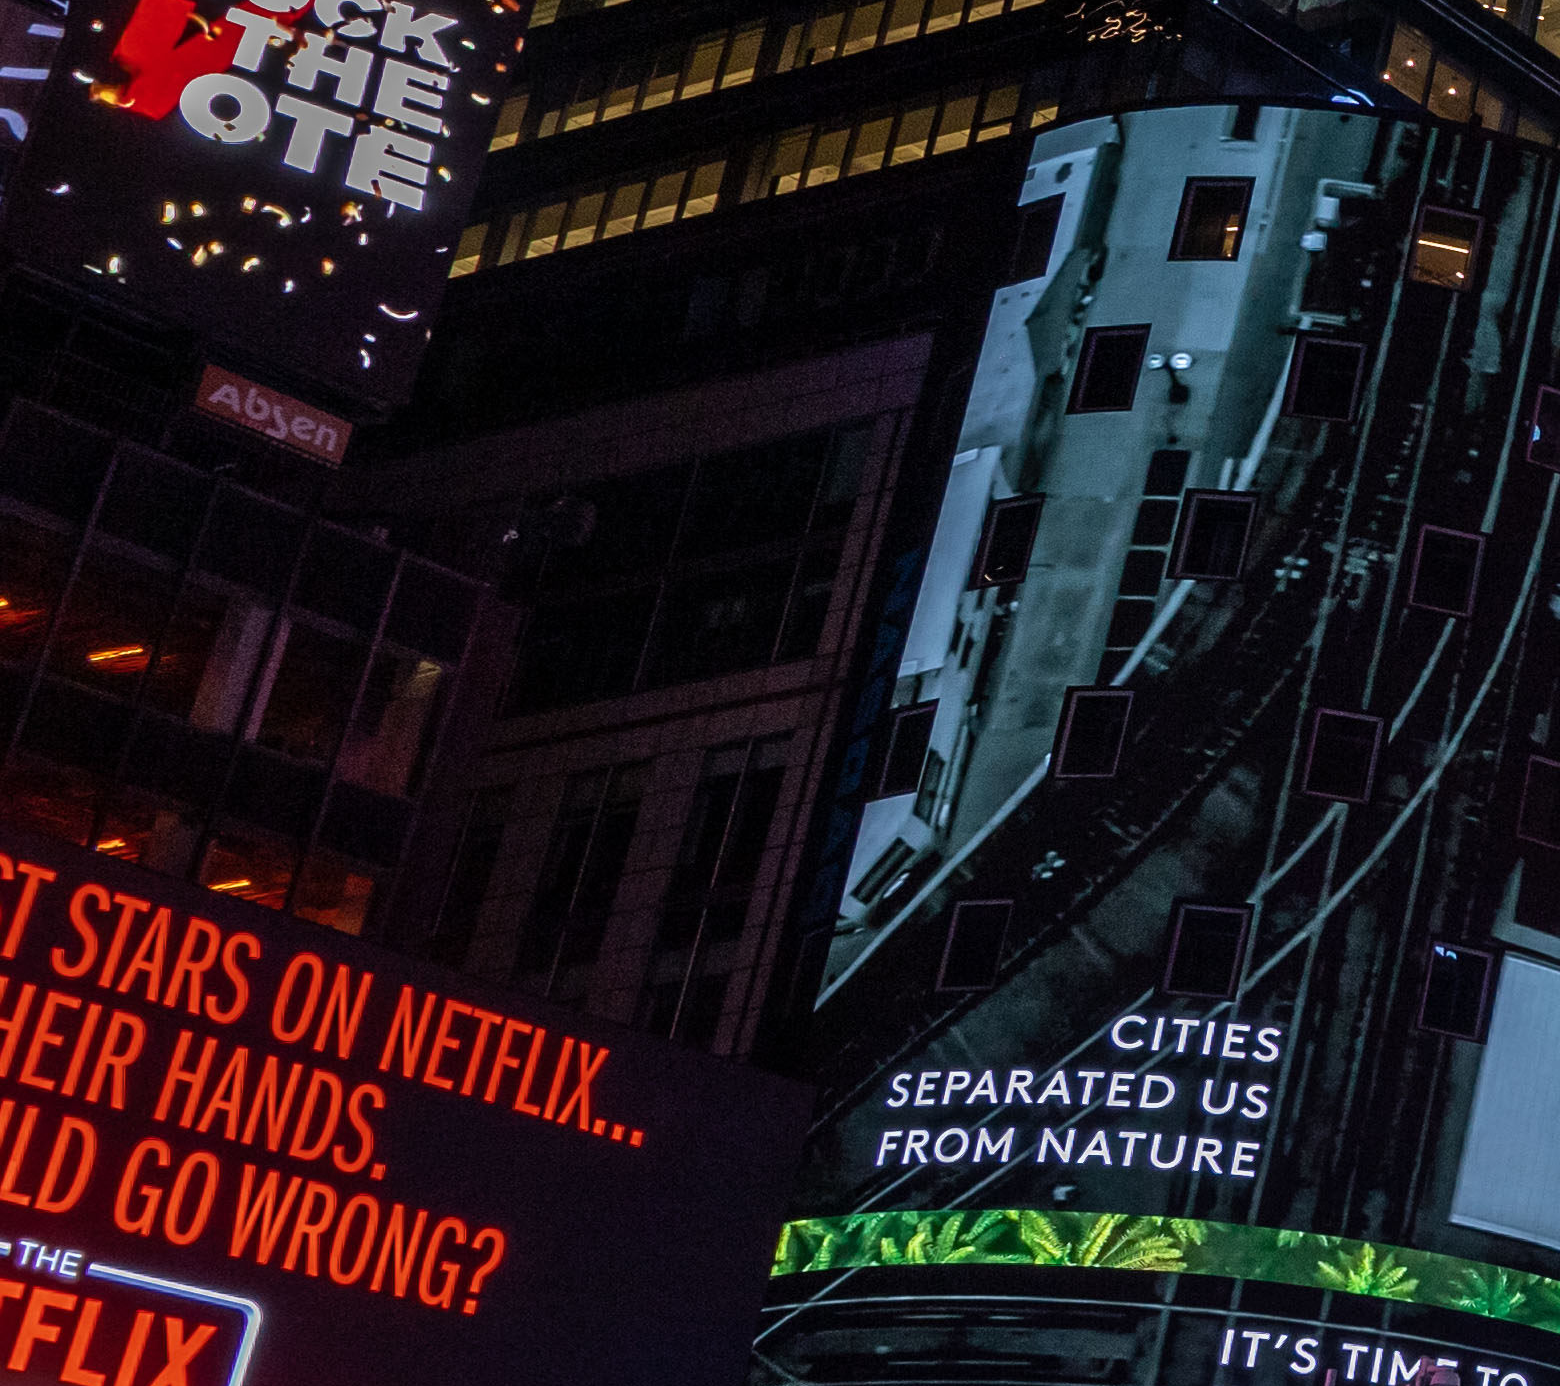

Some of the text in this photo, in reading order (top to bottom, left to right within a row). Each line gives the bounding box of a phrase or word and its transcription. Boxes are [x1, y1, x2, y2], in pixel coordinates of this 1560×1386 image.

[226, 6, 453, 134] THE
[208, 379, 342, 456] Absen
[51, 883, 645, 1149] STARS ON NETFLIX...
[1110, 1014, 1282, 1063] CITIES
[153, 1029, 389, 1181] HANDS.
[886, 1067, 1271, 1120] SEPARATED US
[876, 1126, 1261, 1179] FROM NATURE
[15, 1239, 84, 1278] THE
[113, 1137, 506, 1316] GO WRONG?
[1219, 1327, 1320, 1375] IT'S
